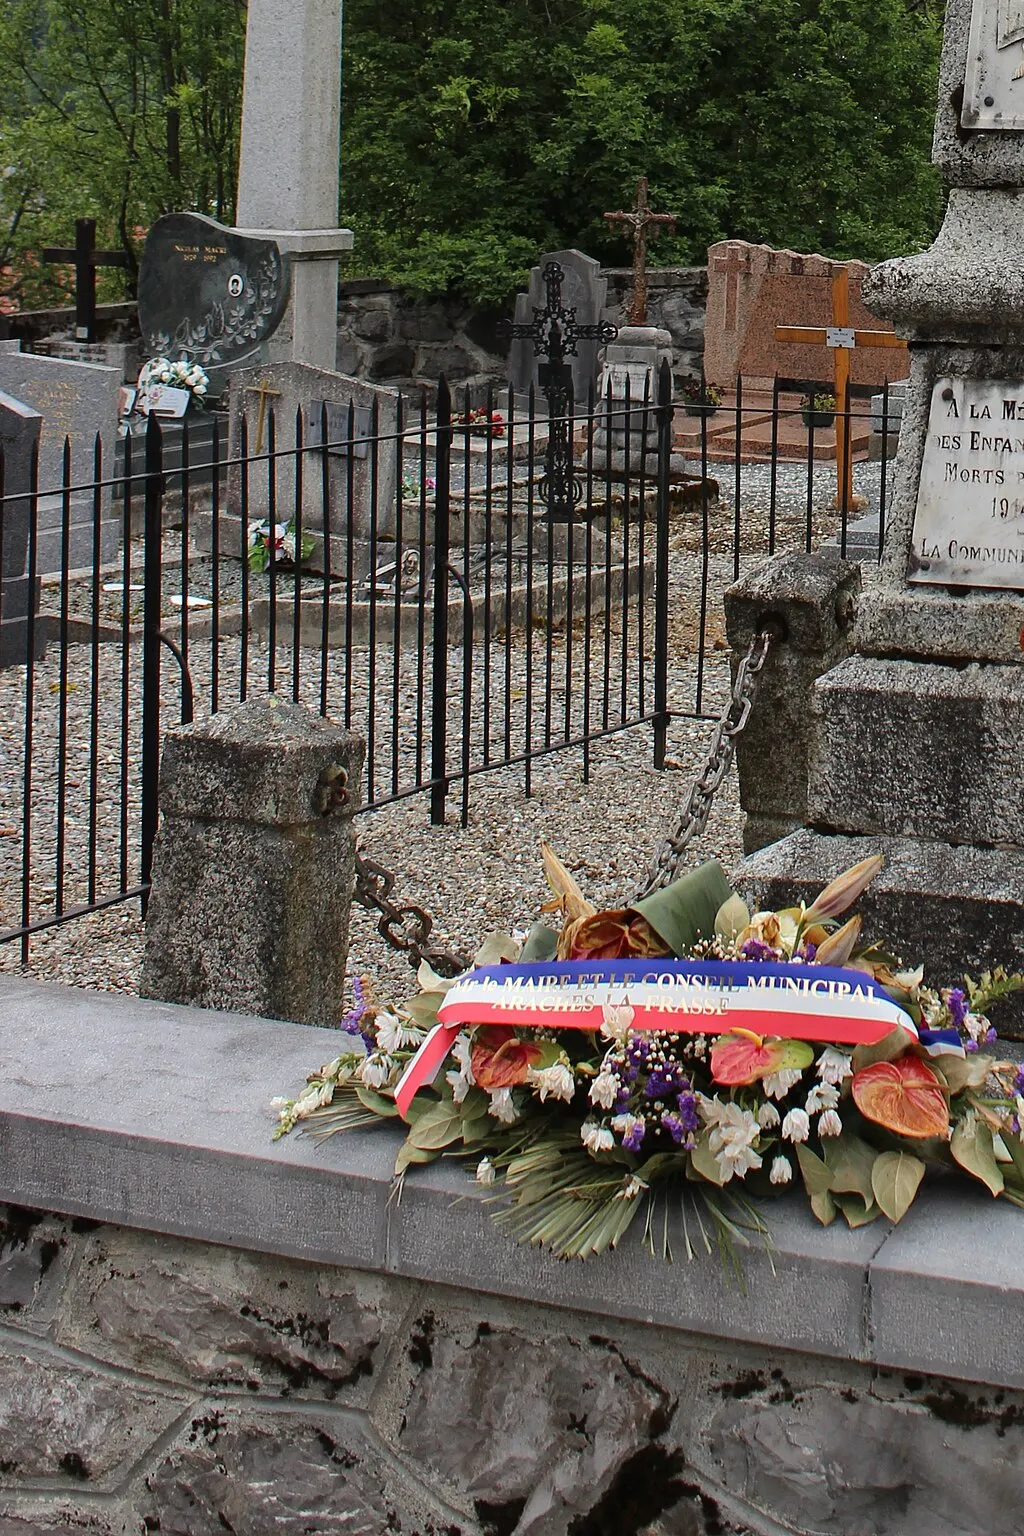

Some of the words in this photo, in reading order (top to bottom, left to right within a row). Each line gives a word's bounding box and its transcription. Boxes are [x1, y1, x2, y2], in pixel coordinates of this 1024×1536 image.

[947, 398, 959, 418] A
[970, 404, 992, 419] LA
[933, 434, 961, 450] DES
[944, 462, 1005, 485] MORTS
[921, 538, 941, 559] LA
[454, 977, 480, 992] Mr
[483, 976, 498, 992] le
[499, 974, 571, 993] MAIRE
[577, 973, 604, 990] ET
[608, 972, 636, 989] LE
[641, 972, 741, 993] CONSEIL
[747, 974, 881, 1005] MUNICIPAL
[491, 994, 595, 1013] ARACHES
[605, 993, 631, 1008] LA
[645, 995, 730, 1016] FRASSE
